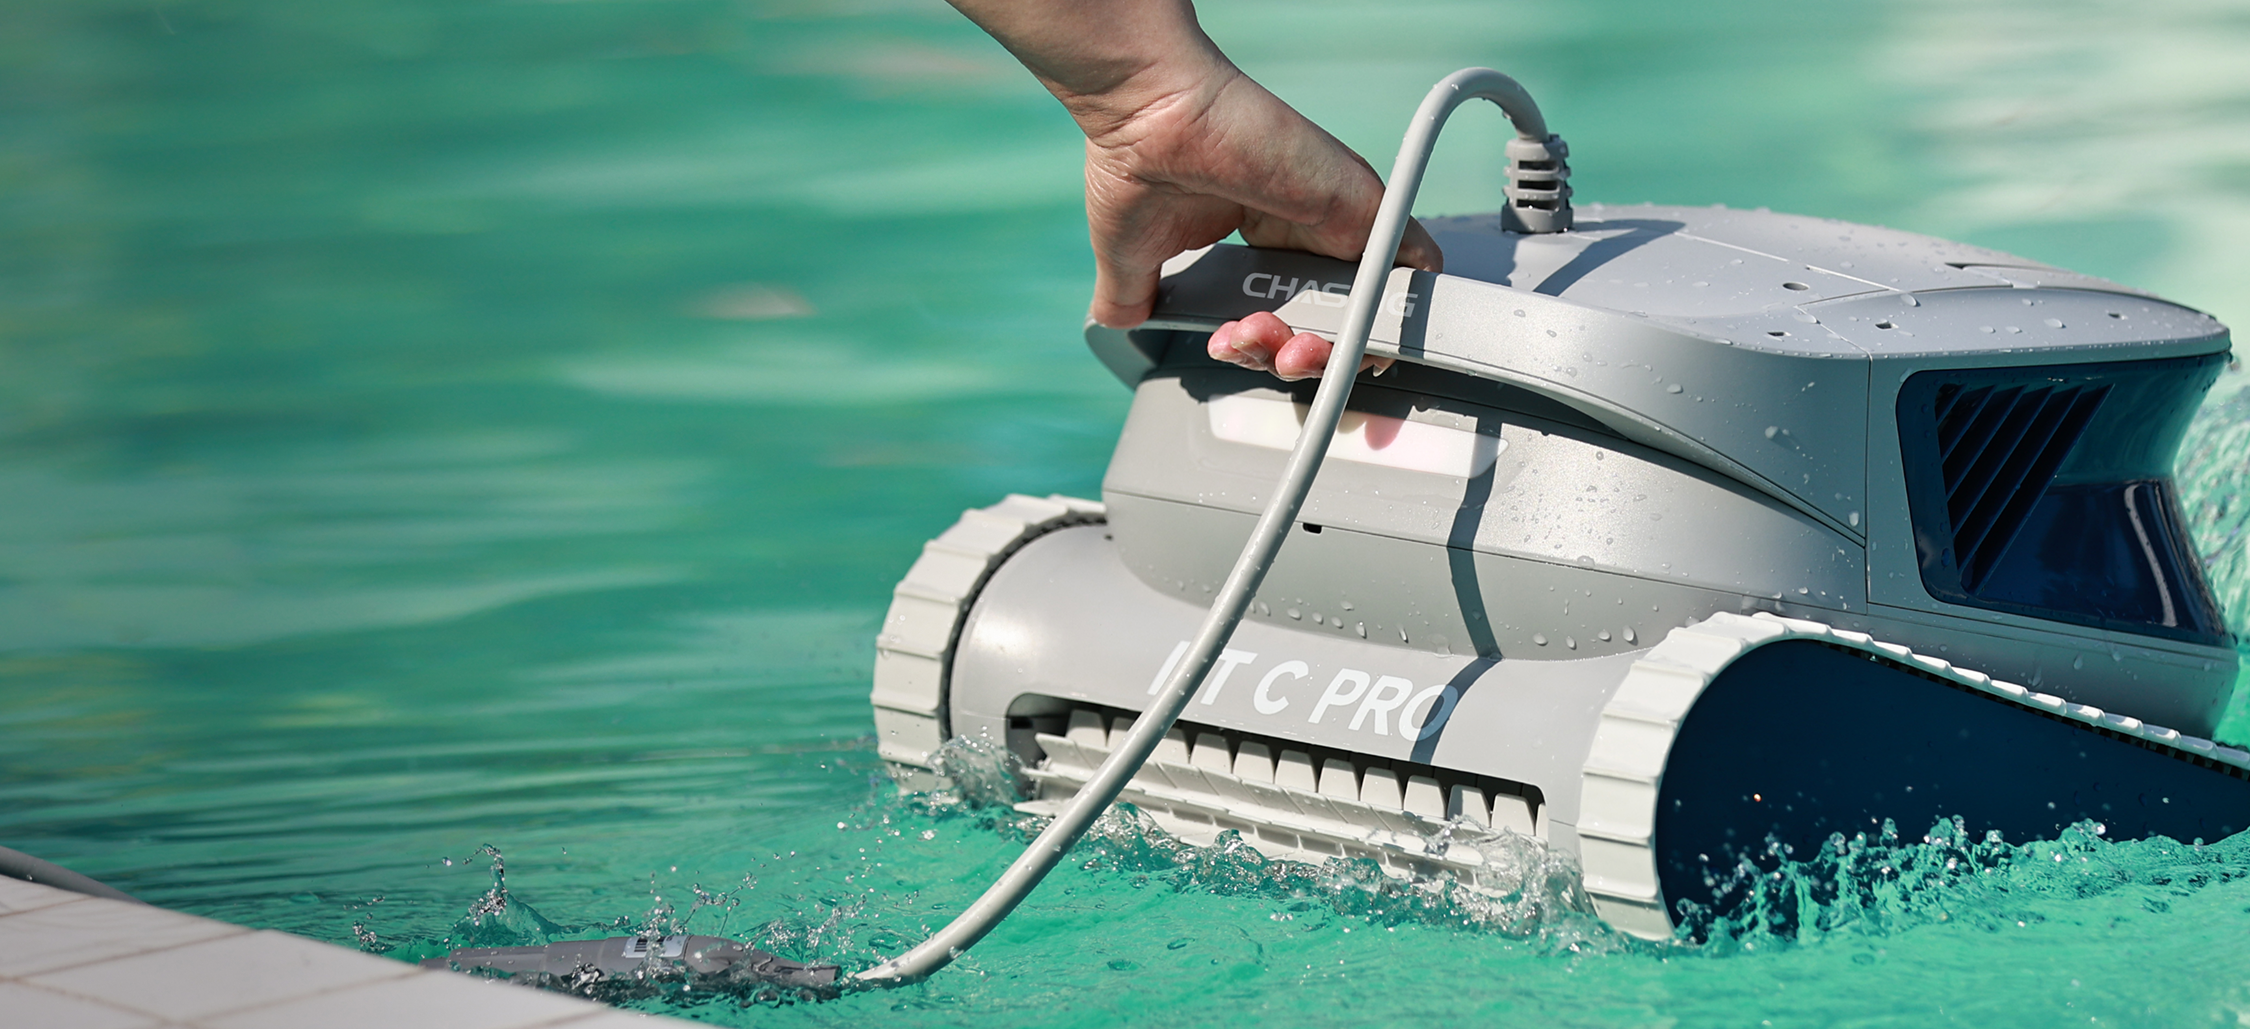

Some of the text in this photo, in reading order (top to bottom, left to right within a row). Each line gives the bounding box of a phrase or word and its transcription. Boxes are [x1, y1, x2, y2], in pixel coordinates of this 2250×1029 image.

[1242, 272, 1418, 318] CHASG
[1253, 660, 1309, 715] C
[1308, 668, 1459, 741] PRO
